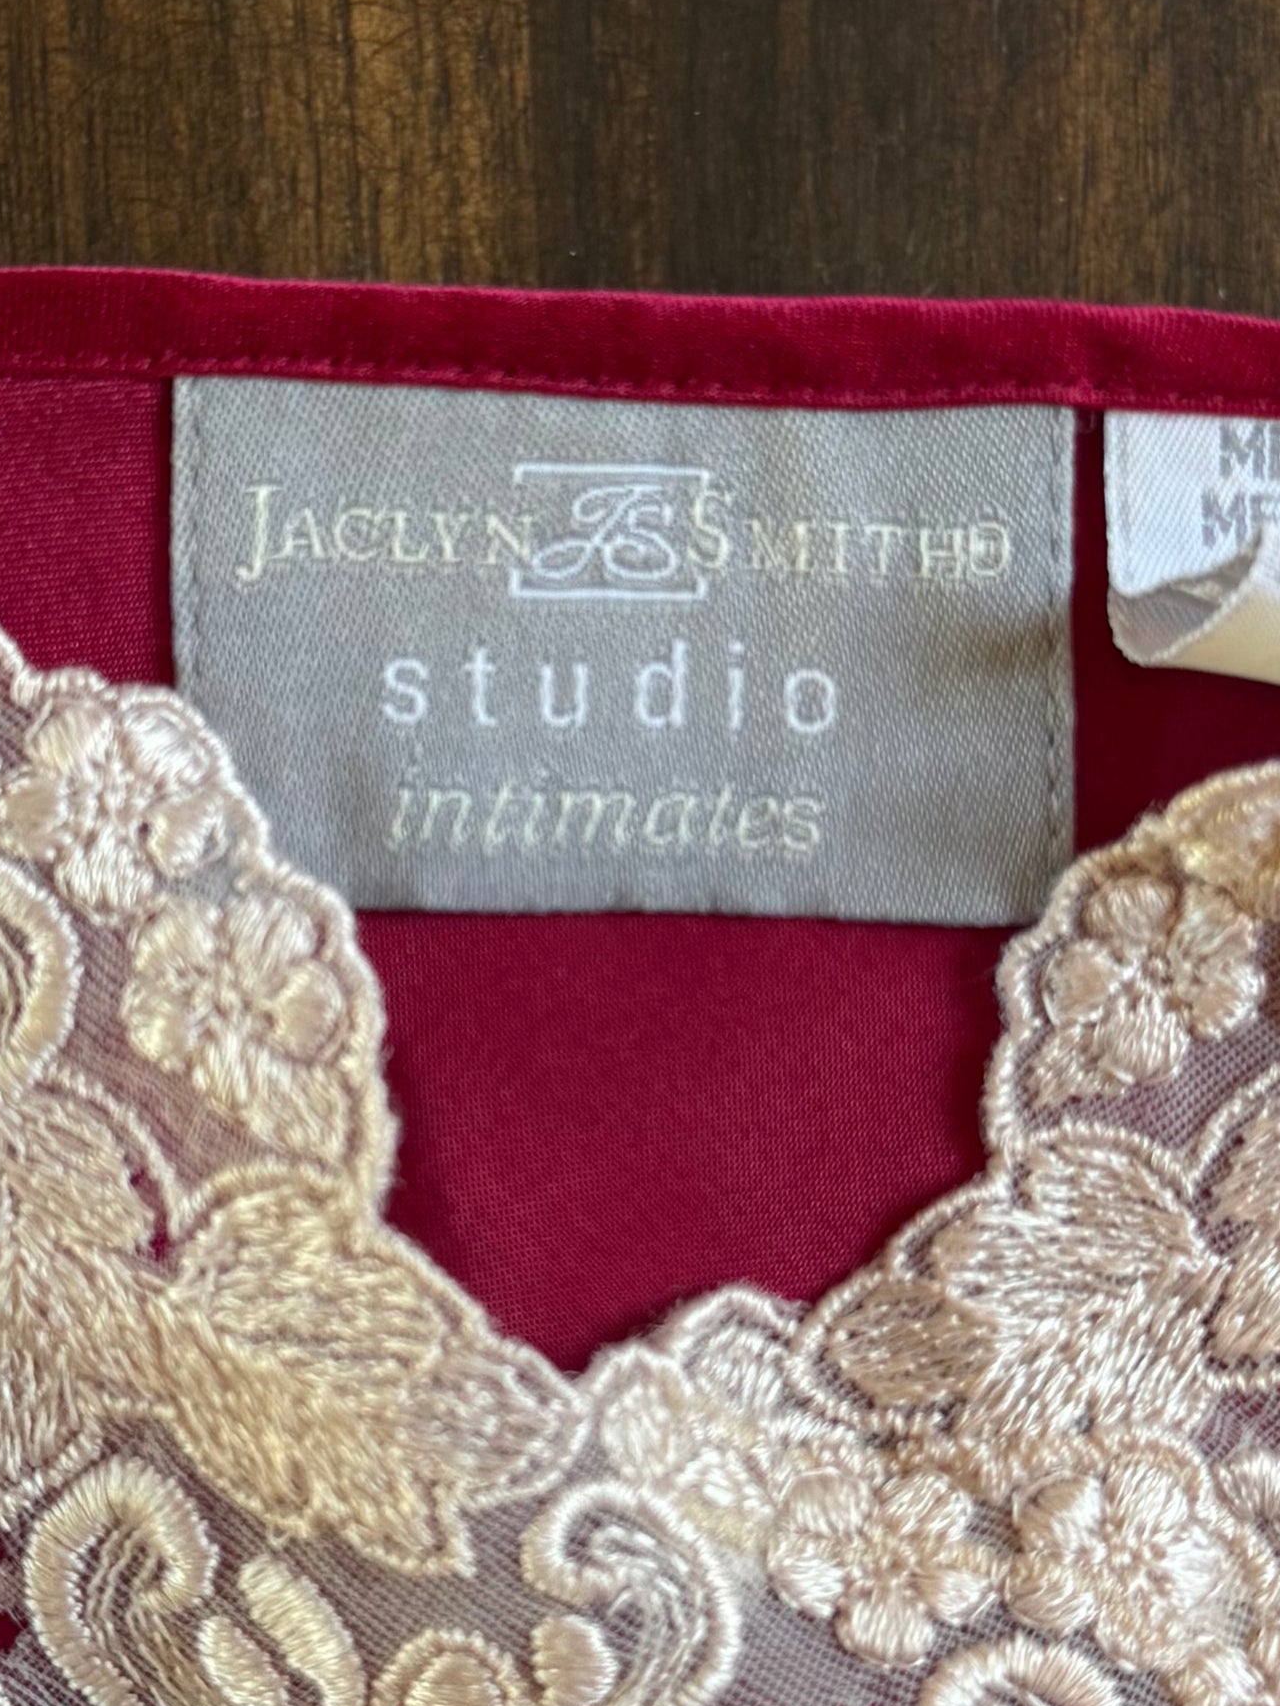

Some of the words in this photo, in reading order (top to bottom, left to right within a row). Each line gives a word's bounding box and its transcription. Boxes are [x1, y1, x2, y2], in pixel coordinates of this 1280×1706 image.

[235, 486, 538, 590] JACLYN
[381, 639, 837, 734] studio
[385, 767, 823, 853] intimates
